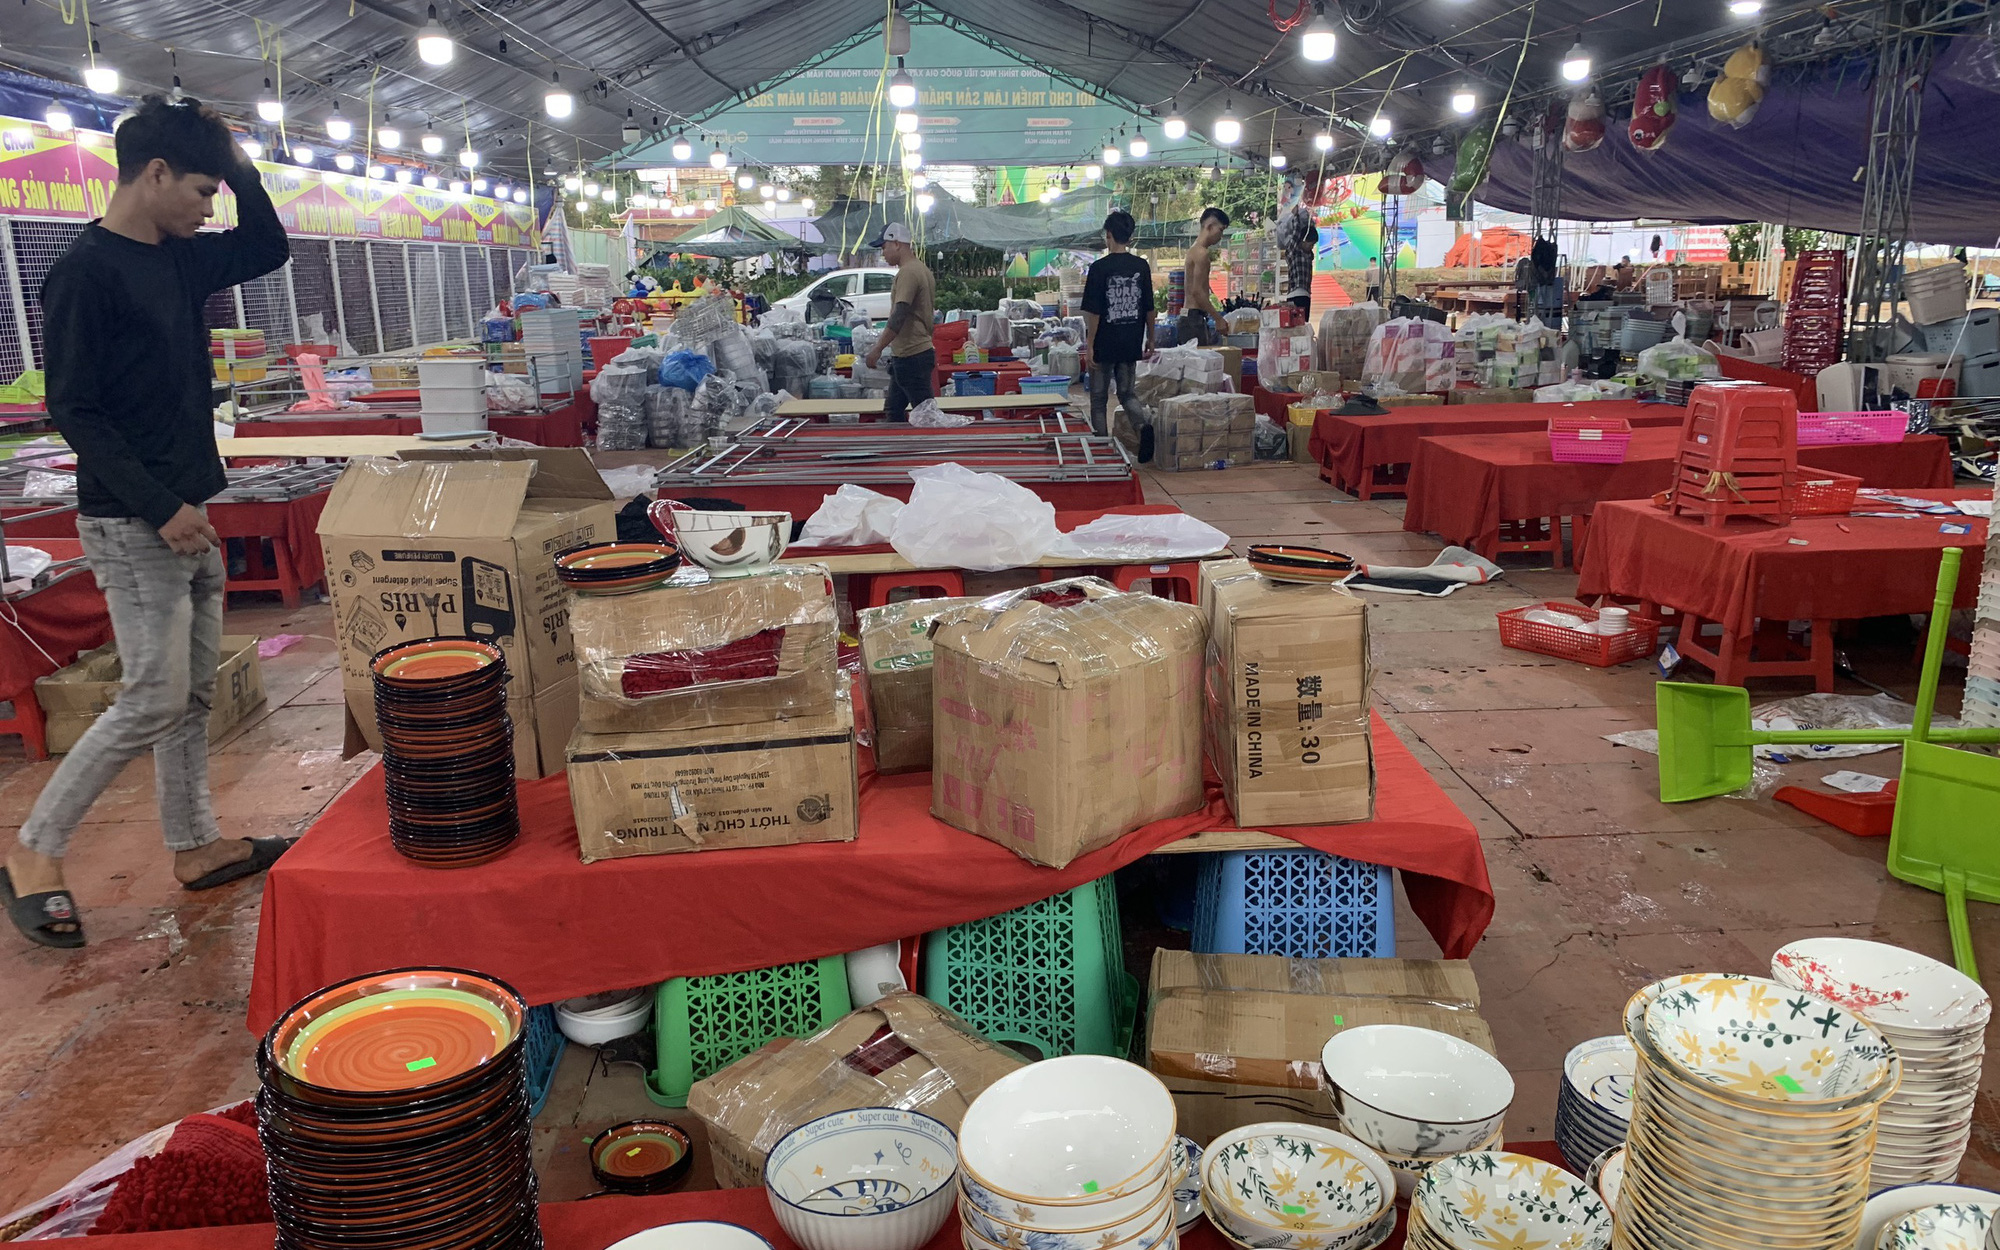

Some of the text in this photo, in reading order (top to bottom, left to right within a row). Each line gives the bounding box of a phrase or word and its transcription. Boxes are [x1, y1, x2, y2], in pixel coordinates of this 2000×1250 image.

[22, 170, 50, 210] SẢN
[50, 167, 87, 213] PHẨM
[372, 575, 409, 586] detergent
[435, 576, 458, 587] Super
[1245, 662, 1263, 779] MADE IN CHINA
[616, 814, 790, 840] THỚT CHỮ NT TRUNG
[804, 1117, 844, 1138] Super cute
[857, 1112, 899, 1125] Super cute
[911, 1114, 932, 1132] Super
